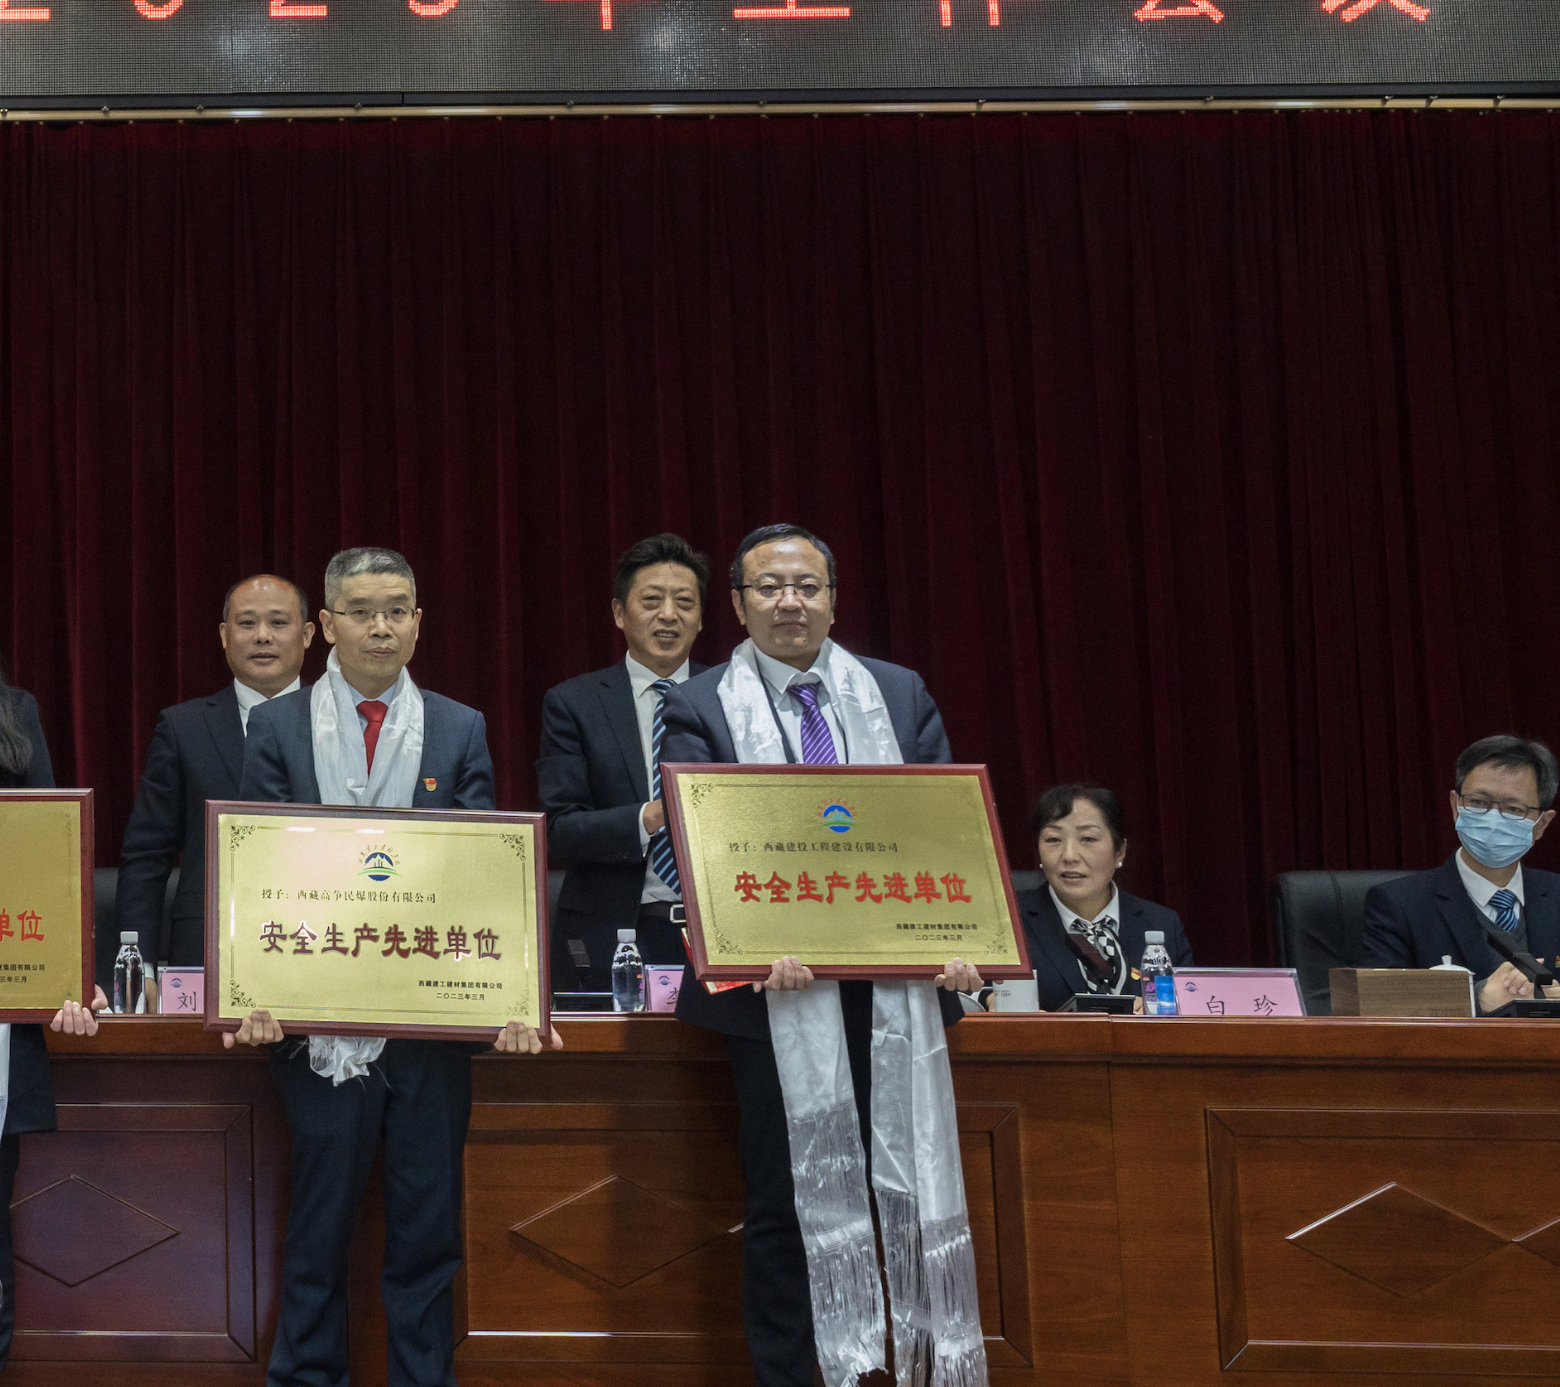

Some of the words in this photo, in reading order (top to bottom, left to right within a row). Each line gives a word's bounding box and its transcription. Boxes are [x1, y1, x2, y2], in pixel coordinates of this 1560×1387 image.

[734, 870, 973, 905] 安全生产先进单位
[259, 919, 503, 962] 安全生产先进单位
[177, 991, 197, 1012] 刘
